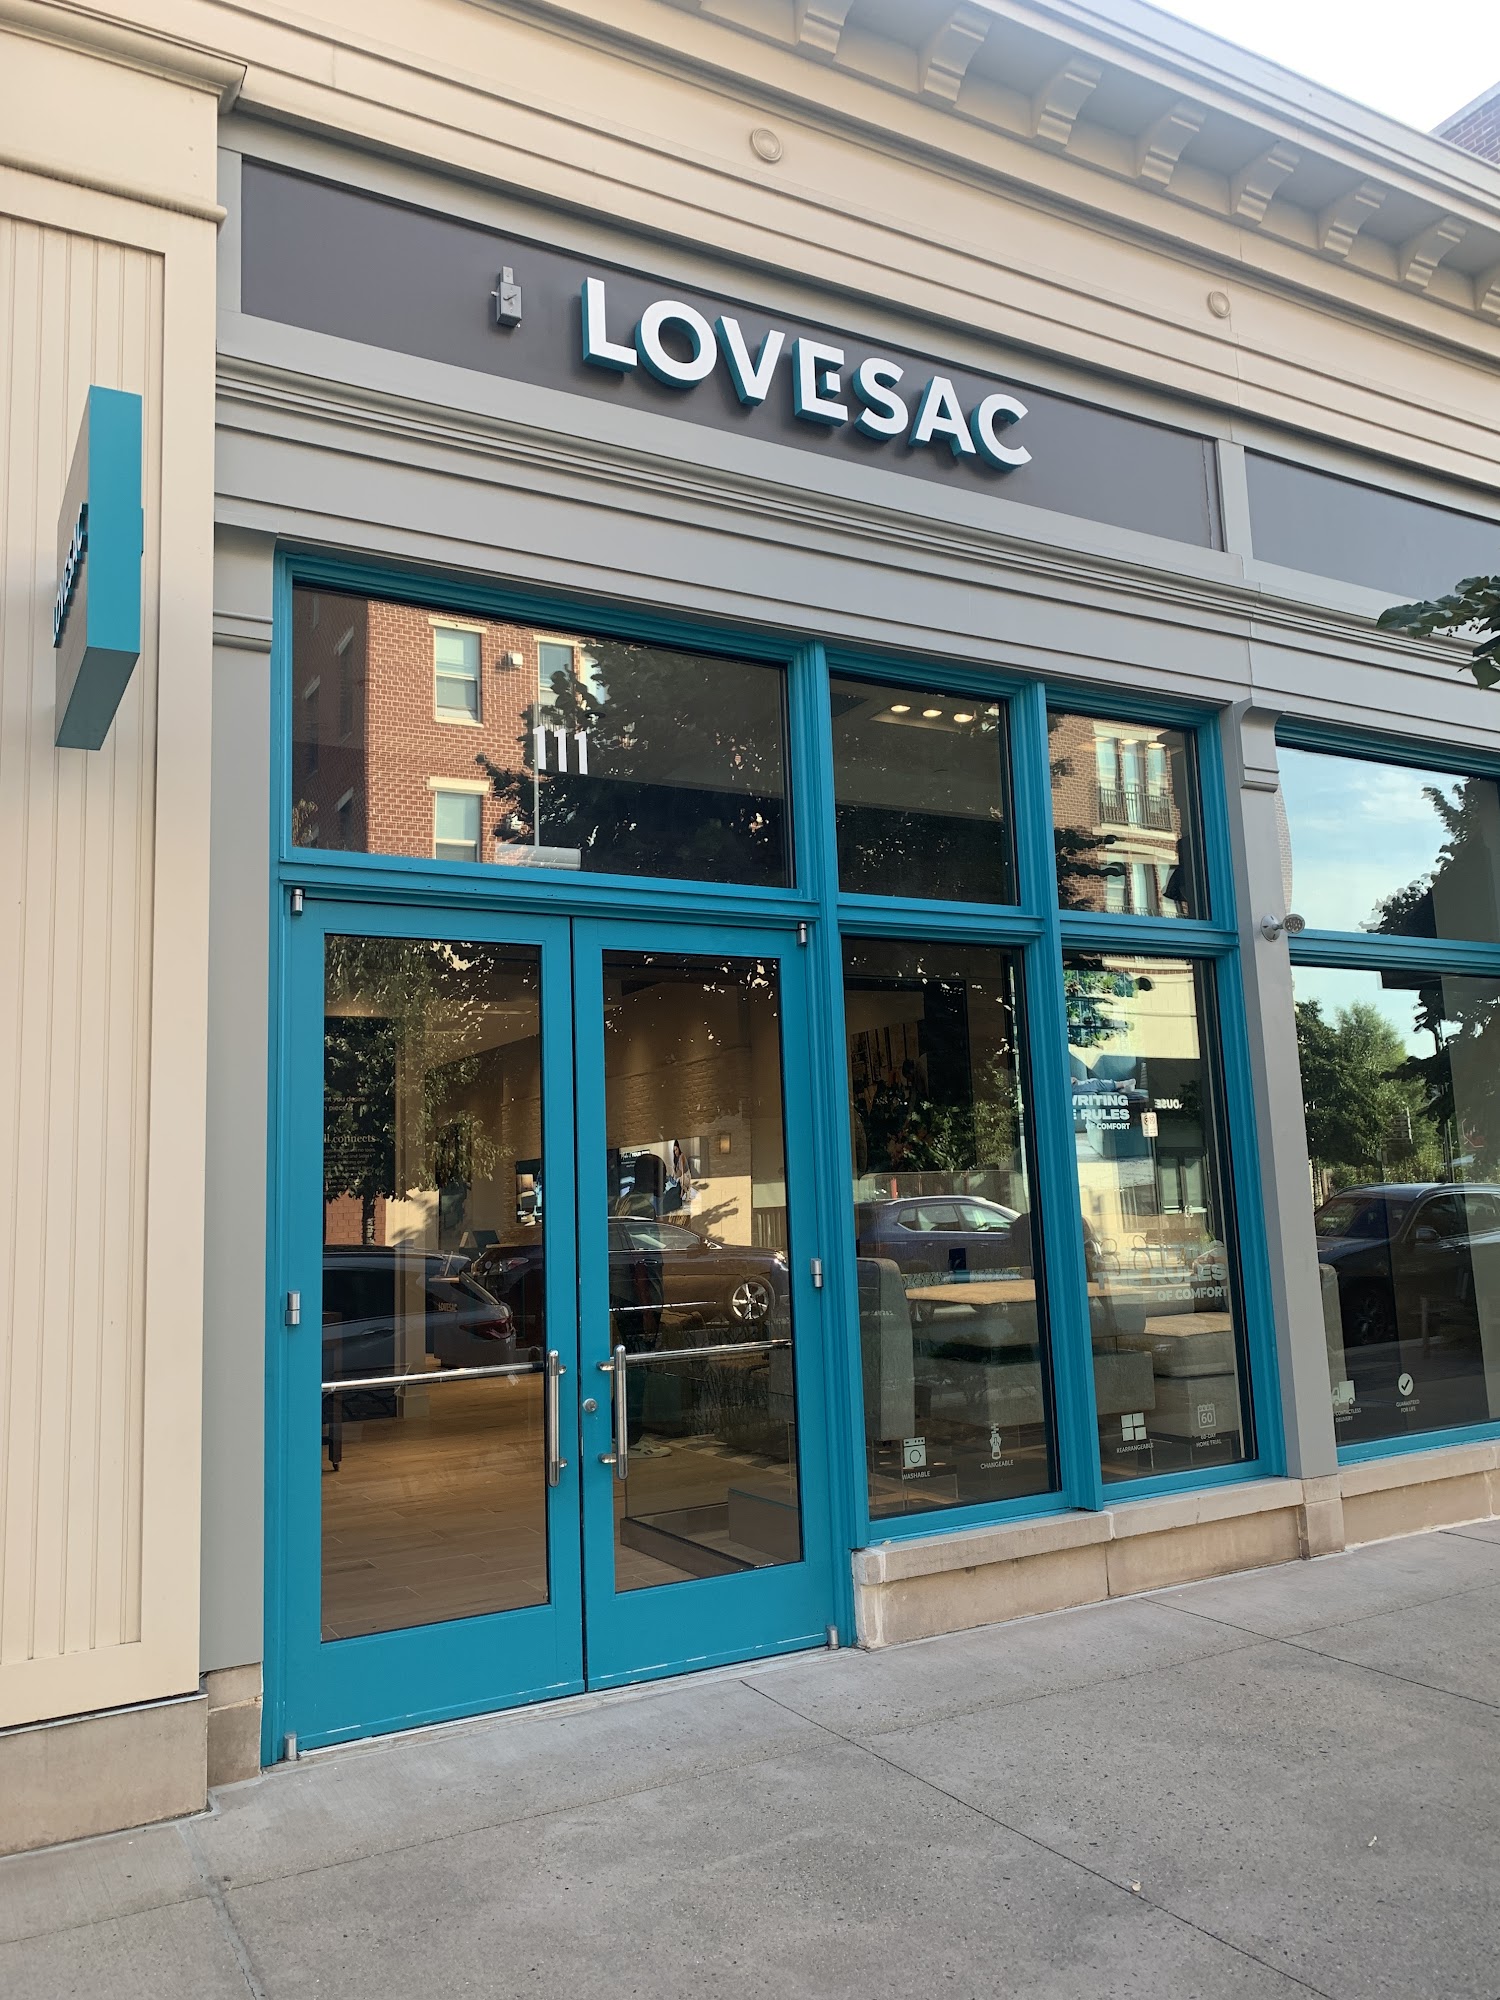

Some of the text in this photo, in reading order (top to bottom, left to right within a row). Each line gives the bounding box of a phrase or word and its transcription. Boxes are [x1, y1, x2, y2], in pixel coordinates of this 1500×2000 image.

[581, 277, 1033, 471] LOVESAC
[533, 725, 588, 775] 111
[1081, 1108, 1131, 1120] RULES
[1096, 1122, 1131, 1130] COMFORT
[333, 1133, 376, 1144] connects
[1157, 1286, 1228, 1301] OF COMFORT
[980, 1459, 1014, 1470] CHANGEABLE
[902, 1470, 931, 1481] WASHABLE
